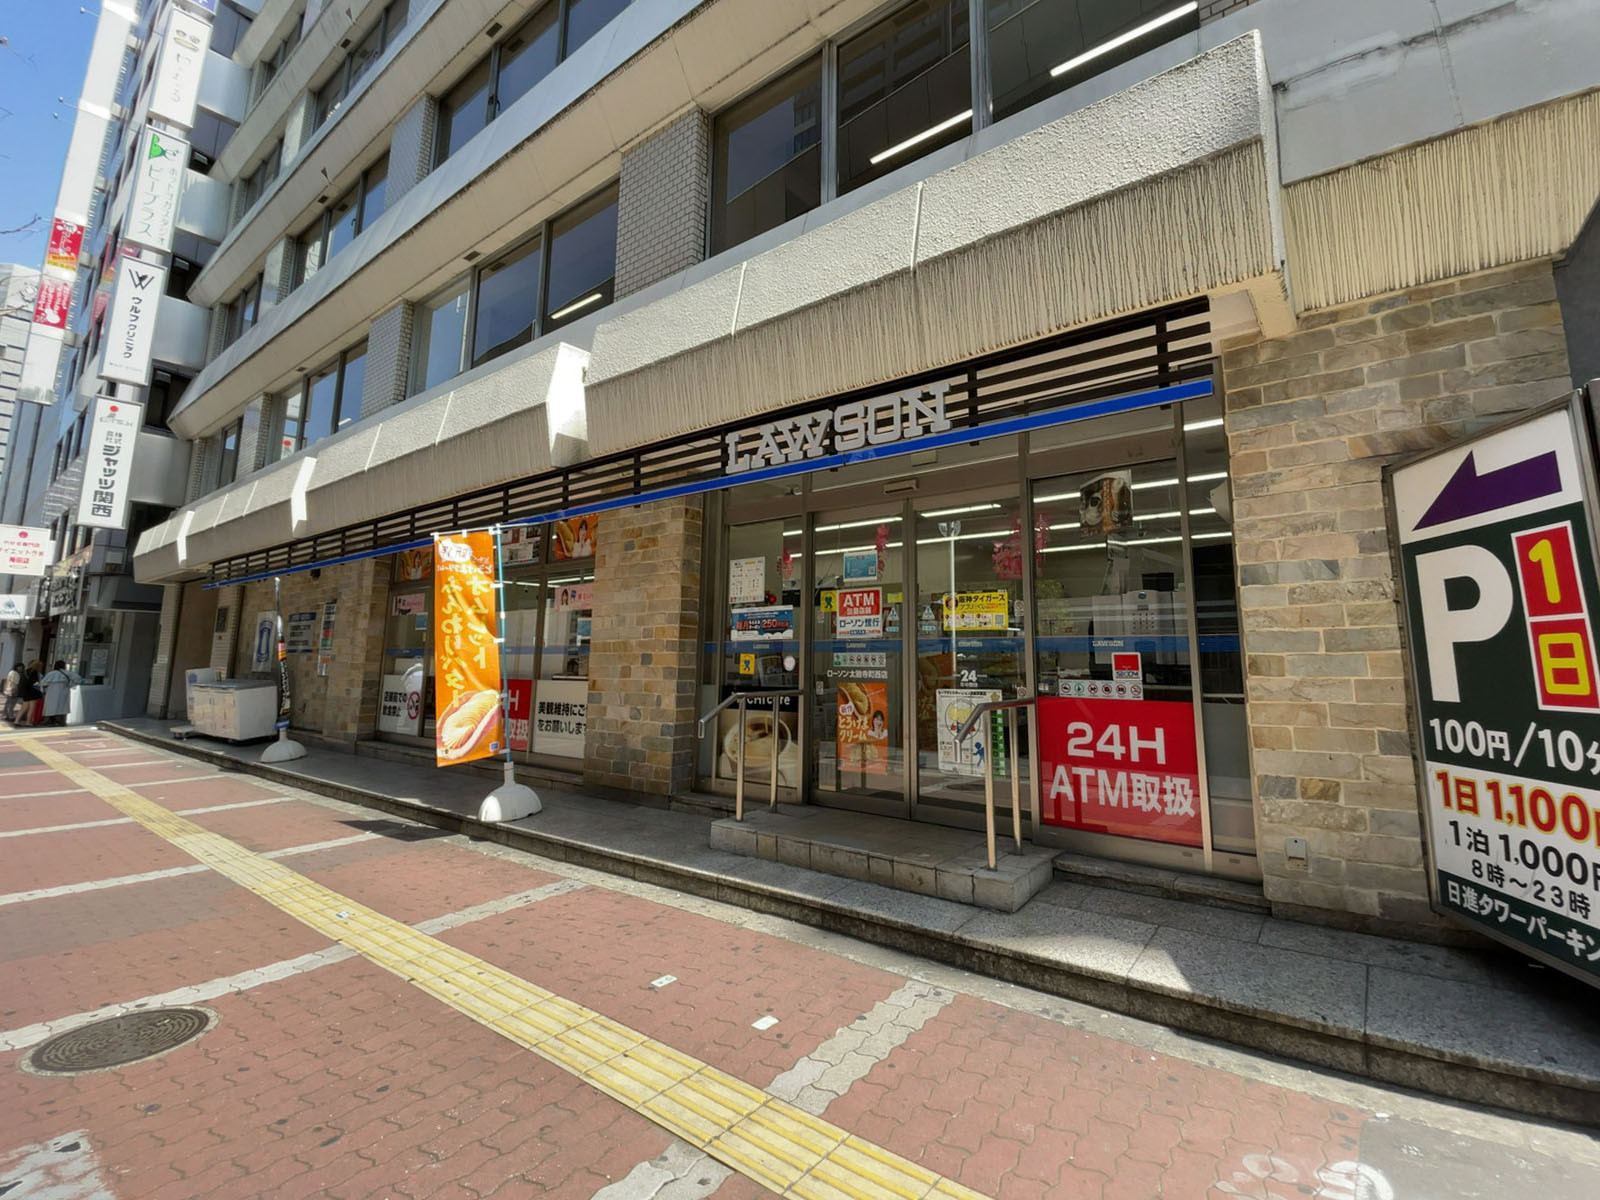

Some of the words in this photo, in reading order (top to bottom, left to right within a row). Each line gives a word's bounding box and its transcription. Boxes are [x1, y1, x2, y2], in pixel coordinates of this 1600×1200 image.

[137, 164, 162, 237] ビープラス
[123, 296, 143, 359] ウルフクリニック
[725, 382, 951, 475] LAWSON
[91, 444, 121, 518] ジャッツ関西
[840, 617, 880, 628] ローソン銀行
[843, 592, 875, 608] ATM
[1415, 544, 1514, 703] P
[961, 670, 977, 682] 24
[538, 701, 588, 717] 美観維持にご
[840, 729, 867, 742] クリーム
[1066, 721, 1166, 765] 24H
[1050, 764, 1196, 818] ATM取扱
[1485, 777, 1600, 848] 1,100
[1498, 833, 1600, 892] 1,000
